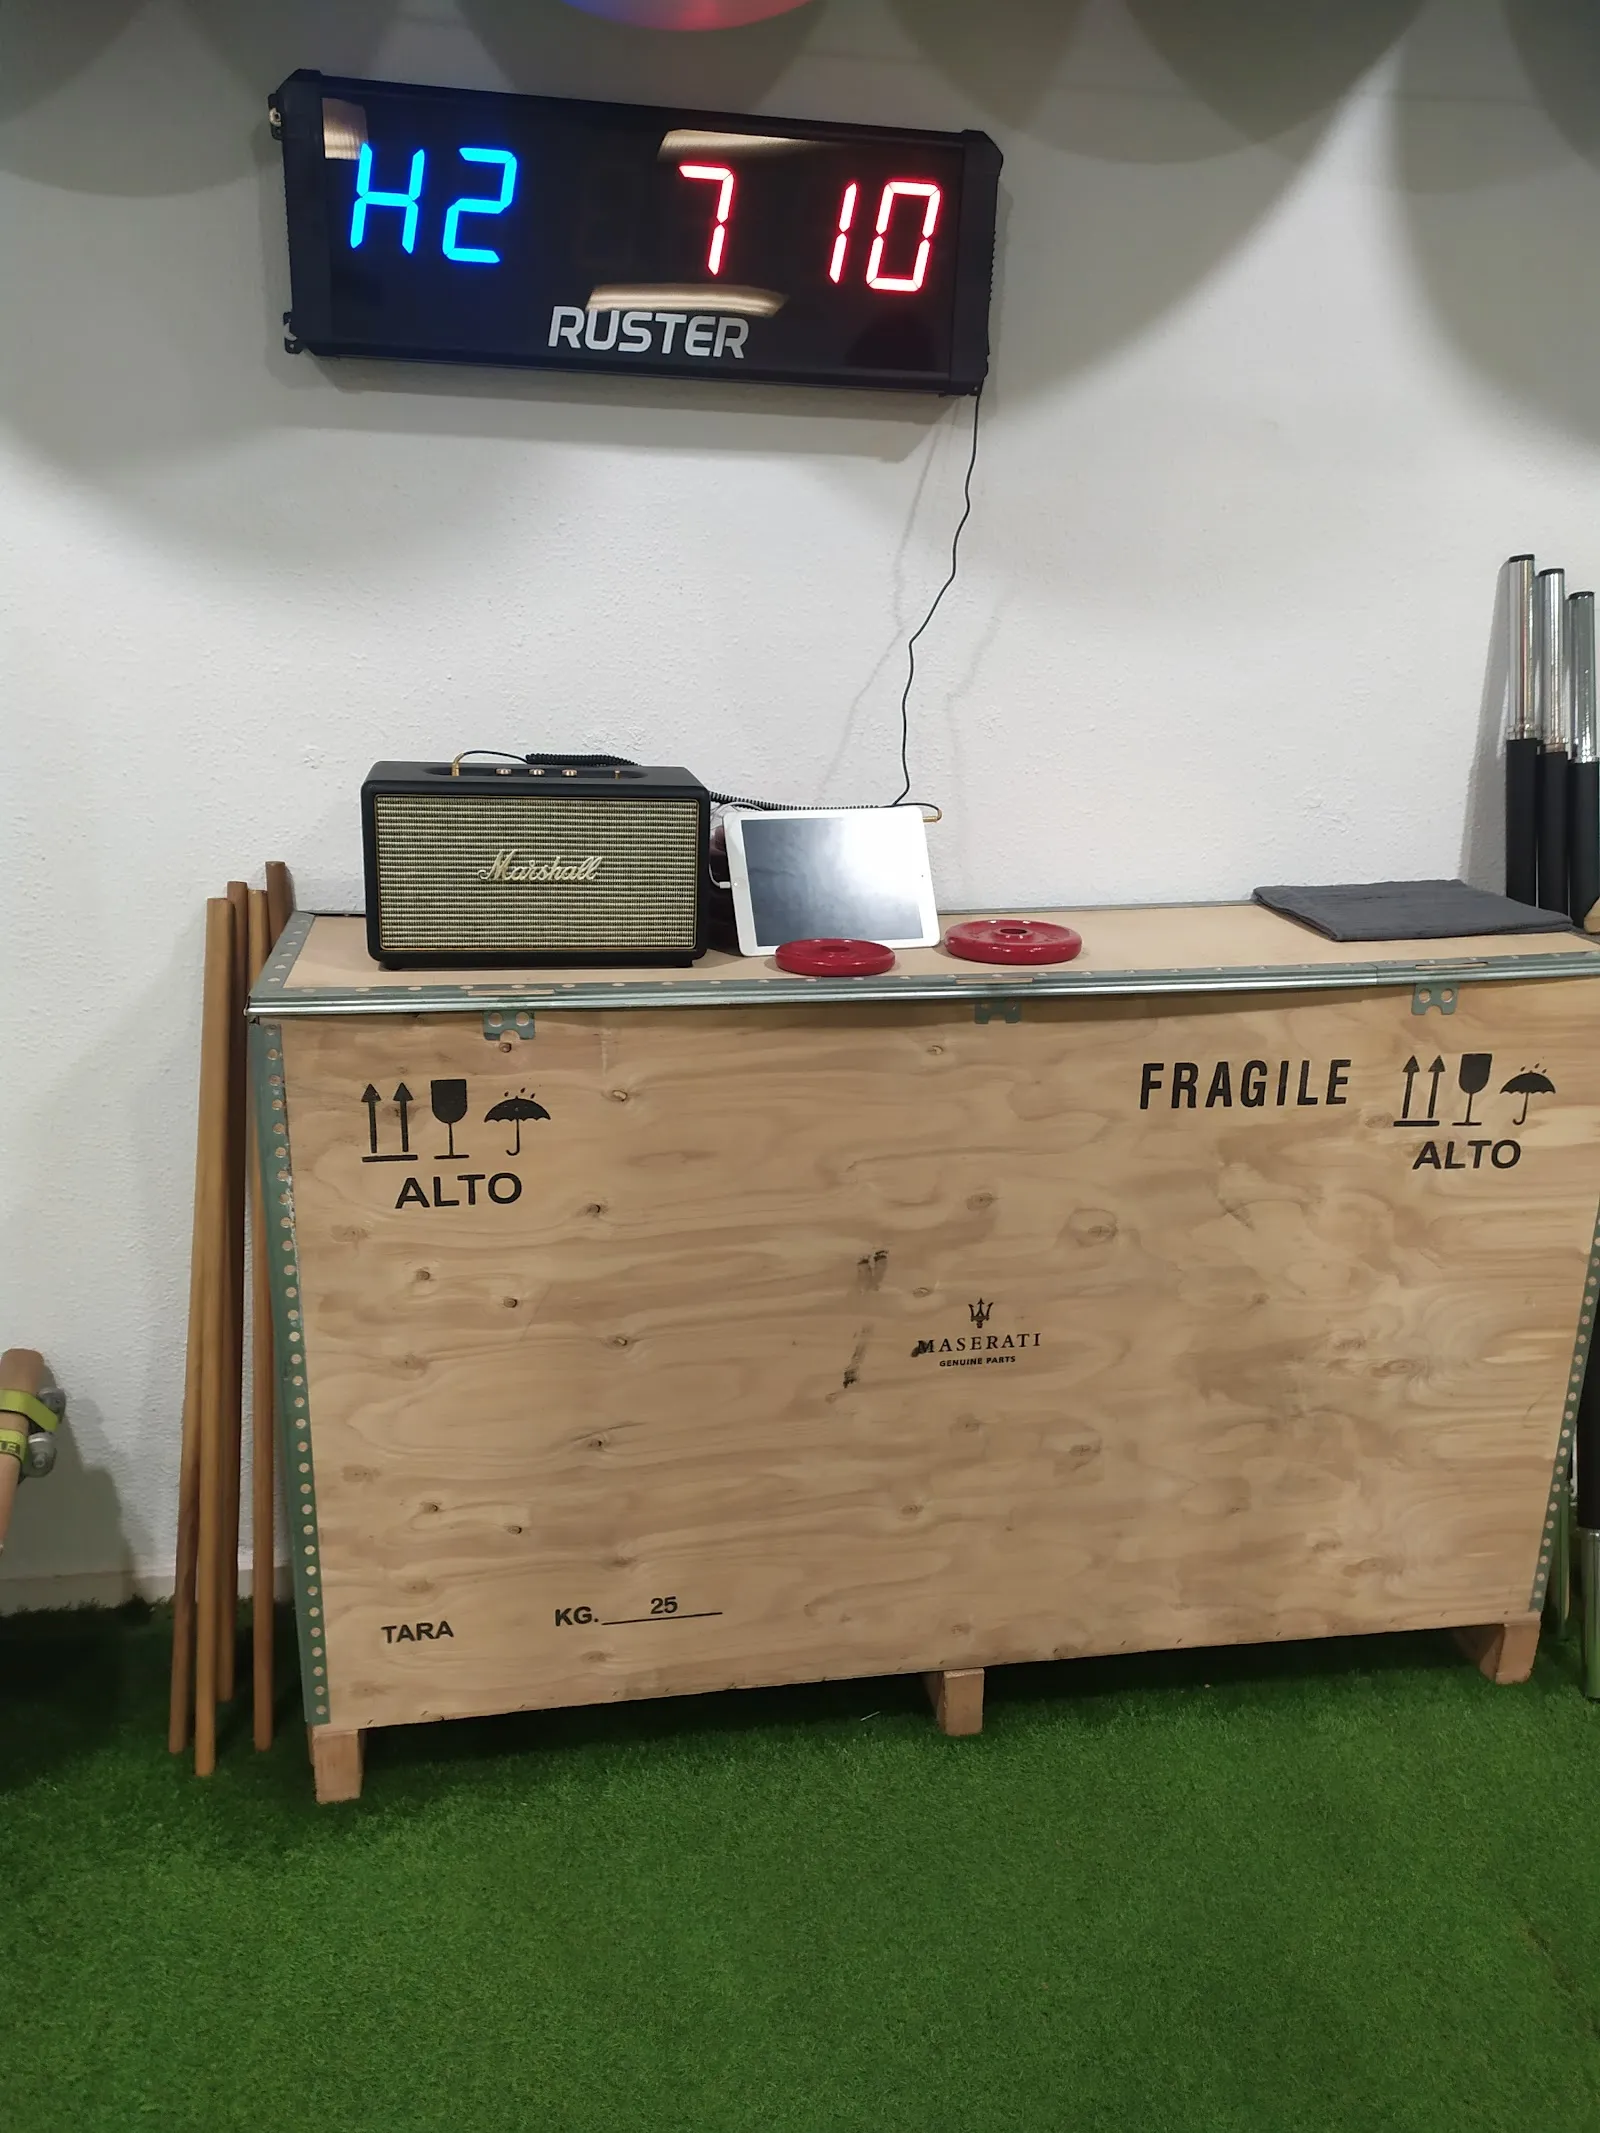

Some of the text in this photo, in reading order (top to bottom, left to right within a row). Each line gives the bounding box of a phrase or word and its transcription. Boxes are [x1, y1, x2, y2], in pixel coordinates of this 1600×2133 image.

[678, 165, 735, 275] 7
[827, 181, 942, 293] 10
[547, 305, 751, 360] RUSTER
[478, 848, 603, 880] Marshall
[1139, 1059, 1352, 1110] FRAGILE
[1412, 1139, 1522, 1170] ALTO
[395, 1172, 523, 1209] ALTO
[917, 1332, 1042, 1354] MASERATI
[939, 1355, 1017, 1368] GENUINE PARTS
[381, 1596, 679, 1645] TARA KG. 25
